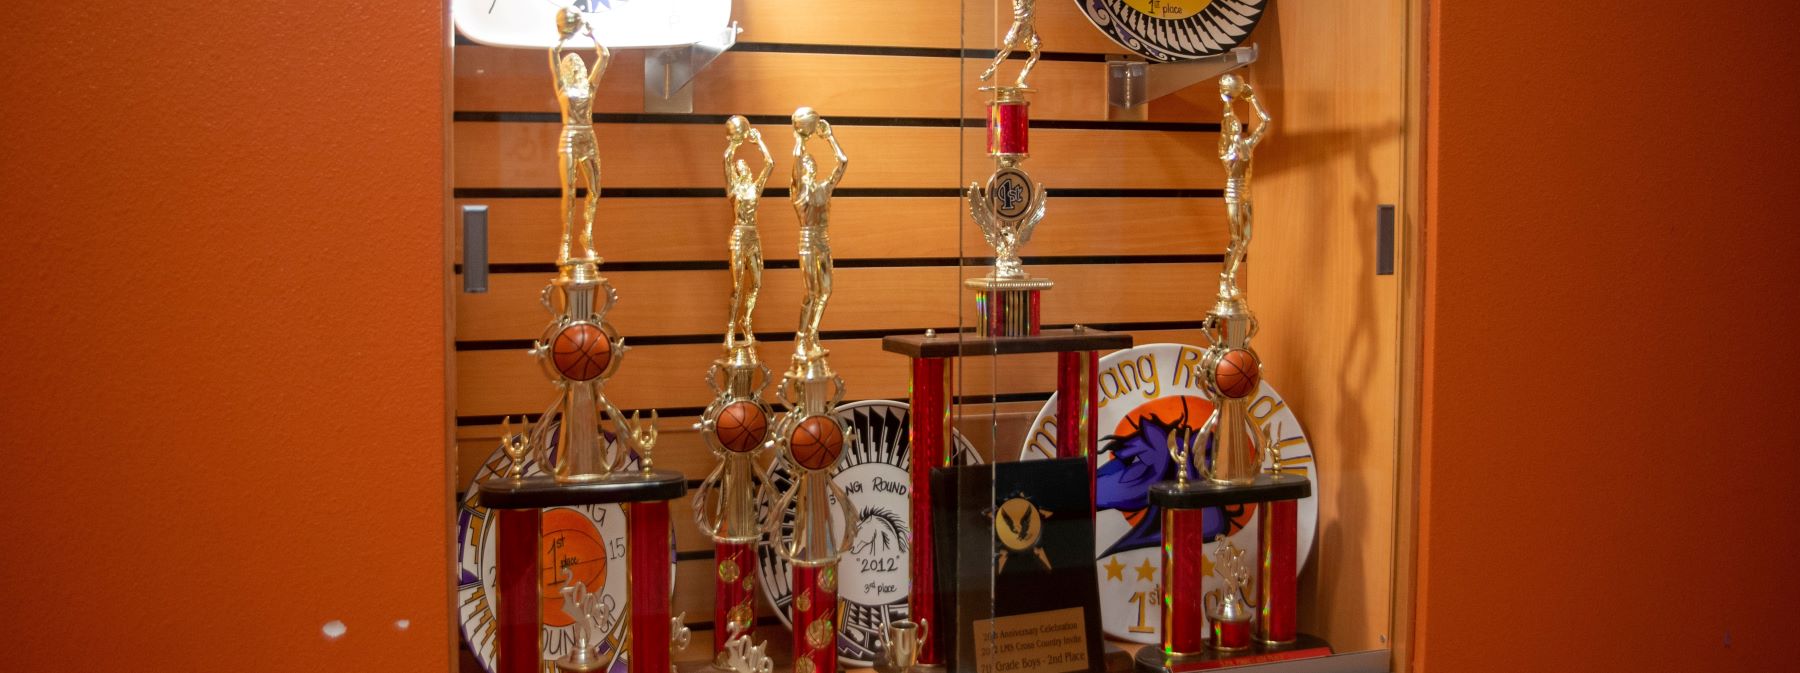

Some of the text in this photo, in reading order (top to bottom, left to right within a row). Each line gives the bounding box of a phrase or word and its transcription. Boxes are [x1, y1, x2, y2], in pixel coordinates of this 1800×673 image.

[1162, 4, 1182, 17] place
[997, 179, 1023, 211] 1st
[877, 582, 897, 597] place
[1000, 627, 1038, 640] Anniversary
[1040, 621, 1078, 634] Celebration
[982, 644, 998, 657] 202
[1016, 640, 1036, 651] Cross
[1037, 638, 1062, 650] Country
[1063, 634, 1082, 645] Invite
[995, 660, 1019, 672] Grade
[1022, 657, 1041, 670] Boys
[1047, 654, 1063, 666] 2nd
[1065, 651, 1086, 664] Place
